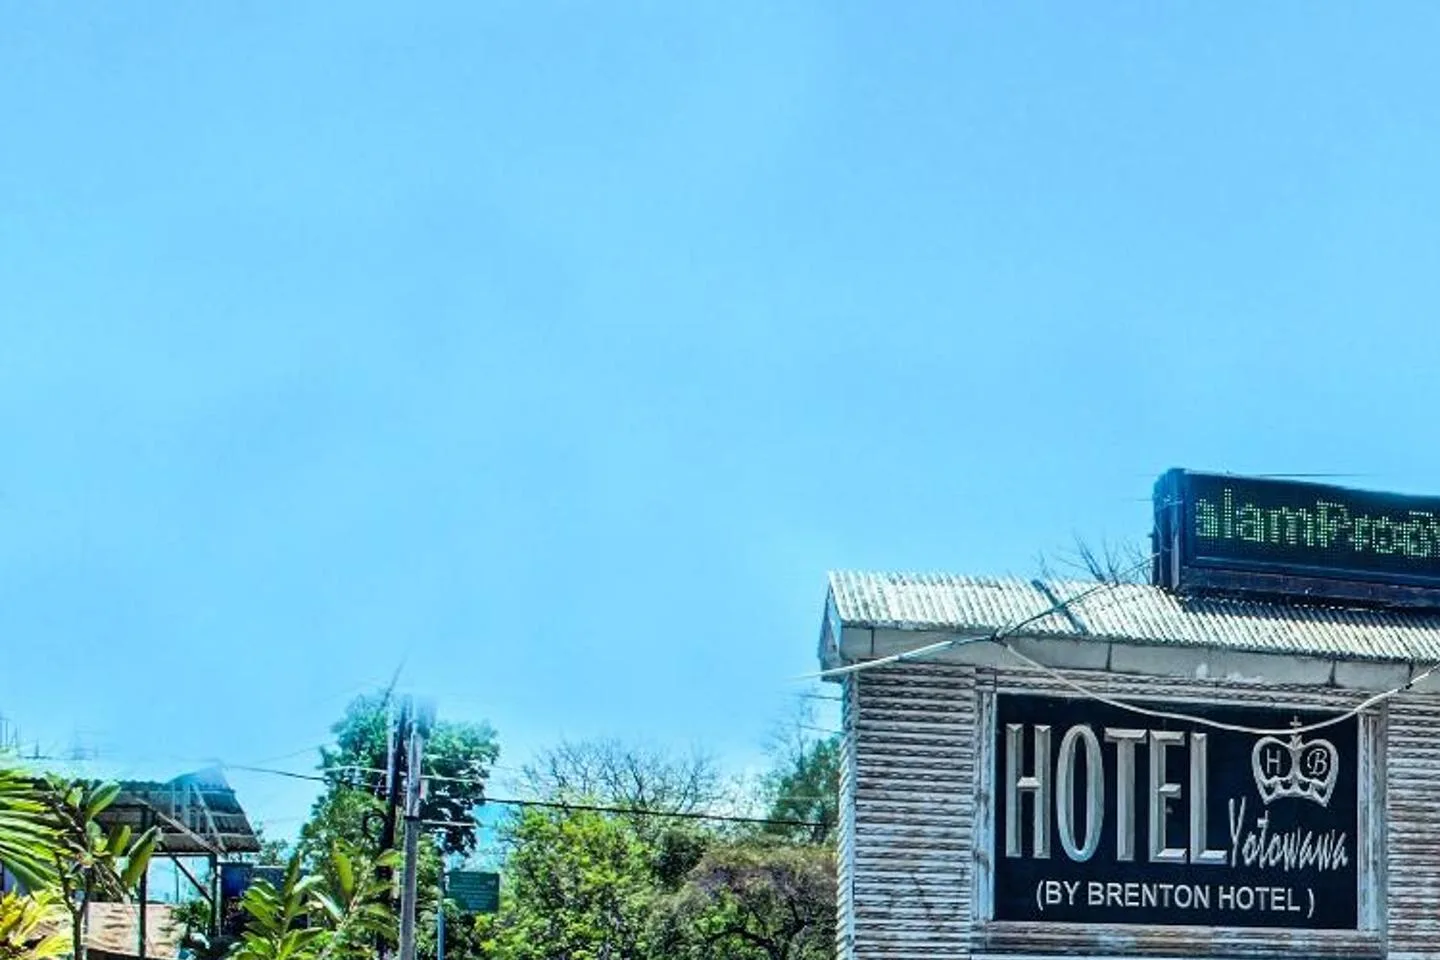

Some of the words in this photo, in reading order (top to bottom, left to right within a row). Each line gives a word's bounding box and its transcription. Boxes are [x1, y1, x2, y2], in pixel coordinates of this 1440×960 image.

[1266, 748, 1282, 775] H
[1306, 747, 1328, 776] B
[1005, 723, 1228, 865] HOTEL
[1228, 795, 1349, 872] Yotowawa
[1036, 880, 1081, 911] (BY
[1087, 881, 1211, 909] BRENTON
